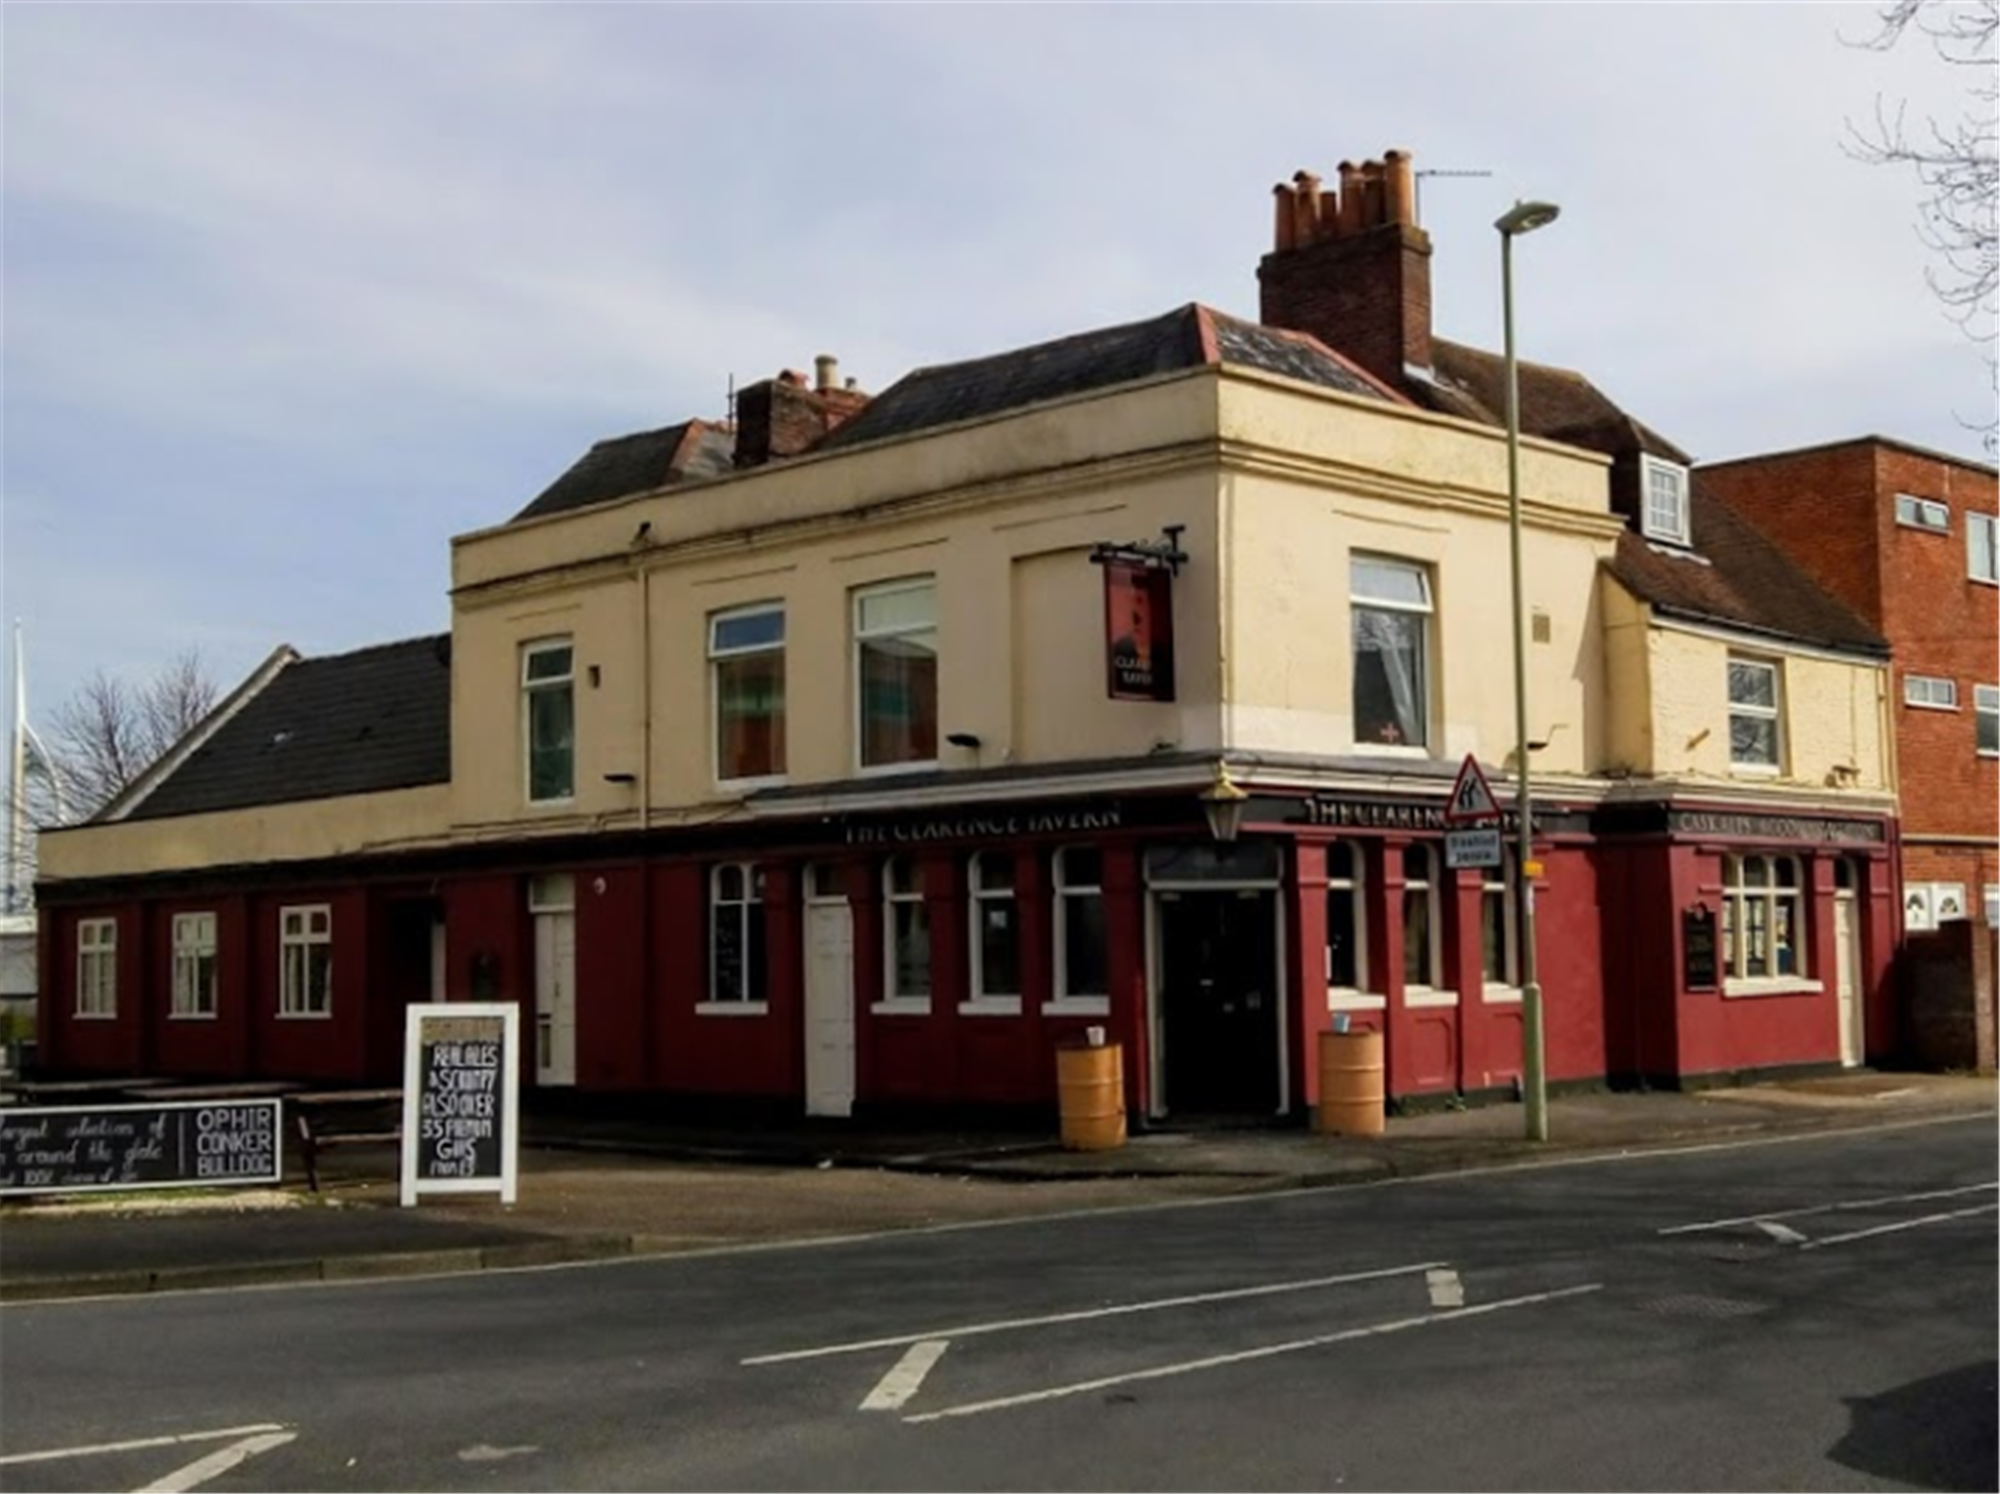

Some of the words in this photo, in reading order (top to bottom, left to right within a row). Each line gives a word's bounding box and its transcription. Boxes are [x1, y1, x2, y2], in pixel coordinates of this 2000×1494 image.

[845, 822, 887, 844] THE
[892, 817, 1020, 841] CLARENCE
[1028, 806, 1122, 832] TAVERN
[1304, 798, 1350, 824] THE
[1356, 803, 1453, 829] CLAREN
[465, 1046, 499, 1067] ALES
[423, 1092, 458, 1118] ALSO
[459, 1094, 494, 1118] OVER
[196, 1108, 271, 1131] OPHIR
[422, 1119, 443, 1139] 35
[17, 1139, 79, 1164] around
[197, 1130, 271, 1154] CONKER
[197, 1154, 272, 1177] BULLDOG
